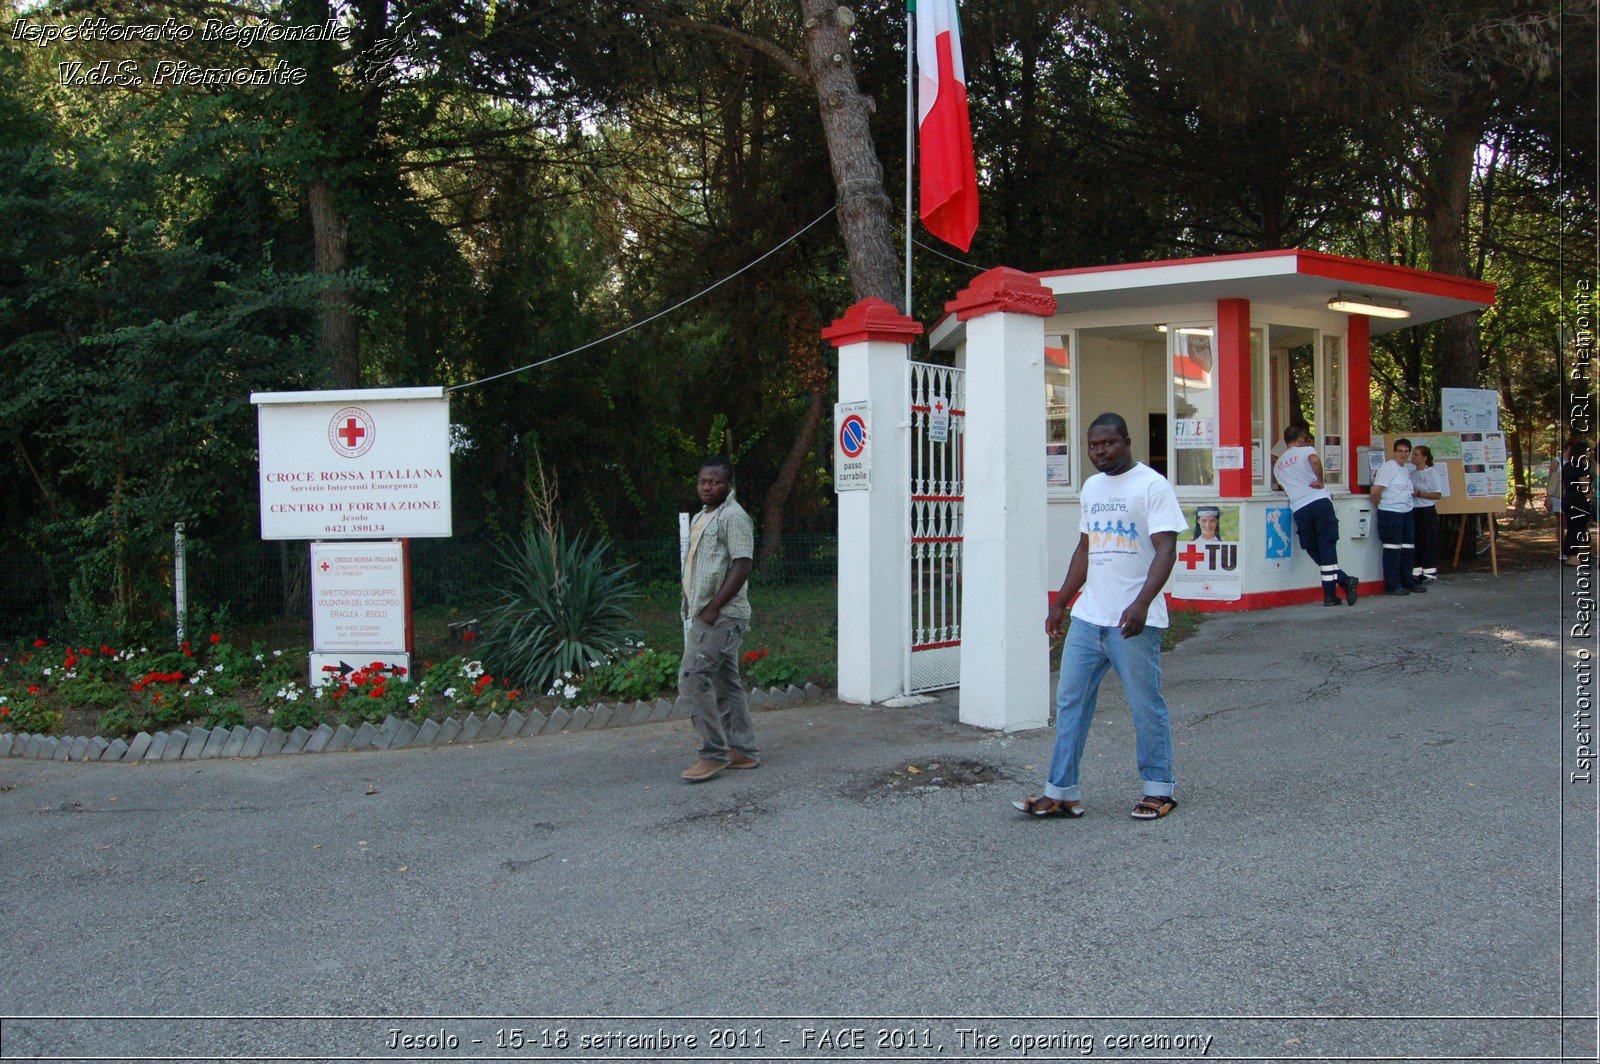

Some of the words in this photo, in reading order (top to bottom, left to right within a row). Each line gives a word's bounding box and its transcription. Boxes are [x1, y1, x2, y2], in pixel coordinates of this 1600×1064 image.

[844, 462, 862, 471] passo
[266, 472, 315, 483] CROCE
[321, 470, 364, 482] ROSSA
[370, 468, 443, 480] ITALIANA
[839, 471, 867, 481] carrabile
[290, 484, 325, 492] Servizio
[327, 483, 368, 491] Interventi
[371, 482, 418, 492] Emergenza
[270, 503, 325, 513] CENTRO
[330, 503, 343, 512] DI
[349, 501, 441, 511] FORMAZIONE
[325, 525, 347, 533] 0421
[351, 524, 385, 532] 380134
[1205, 544, 1237, 571] TU
[320, 589, 362, 597] ISPETTORATO
[318, 599, 350, 607] VOLONTARI
